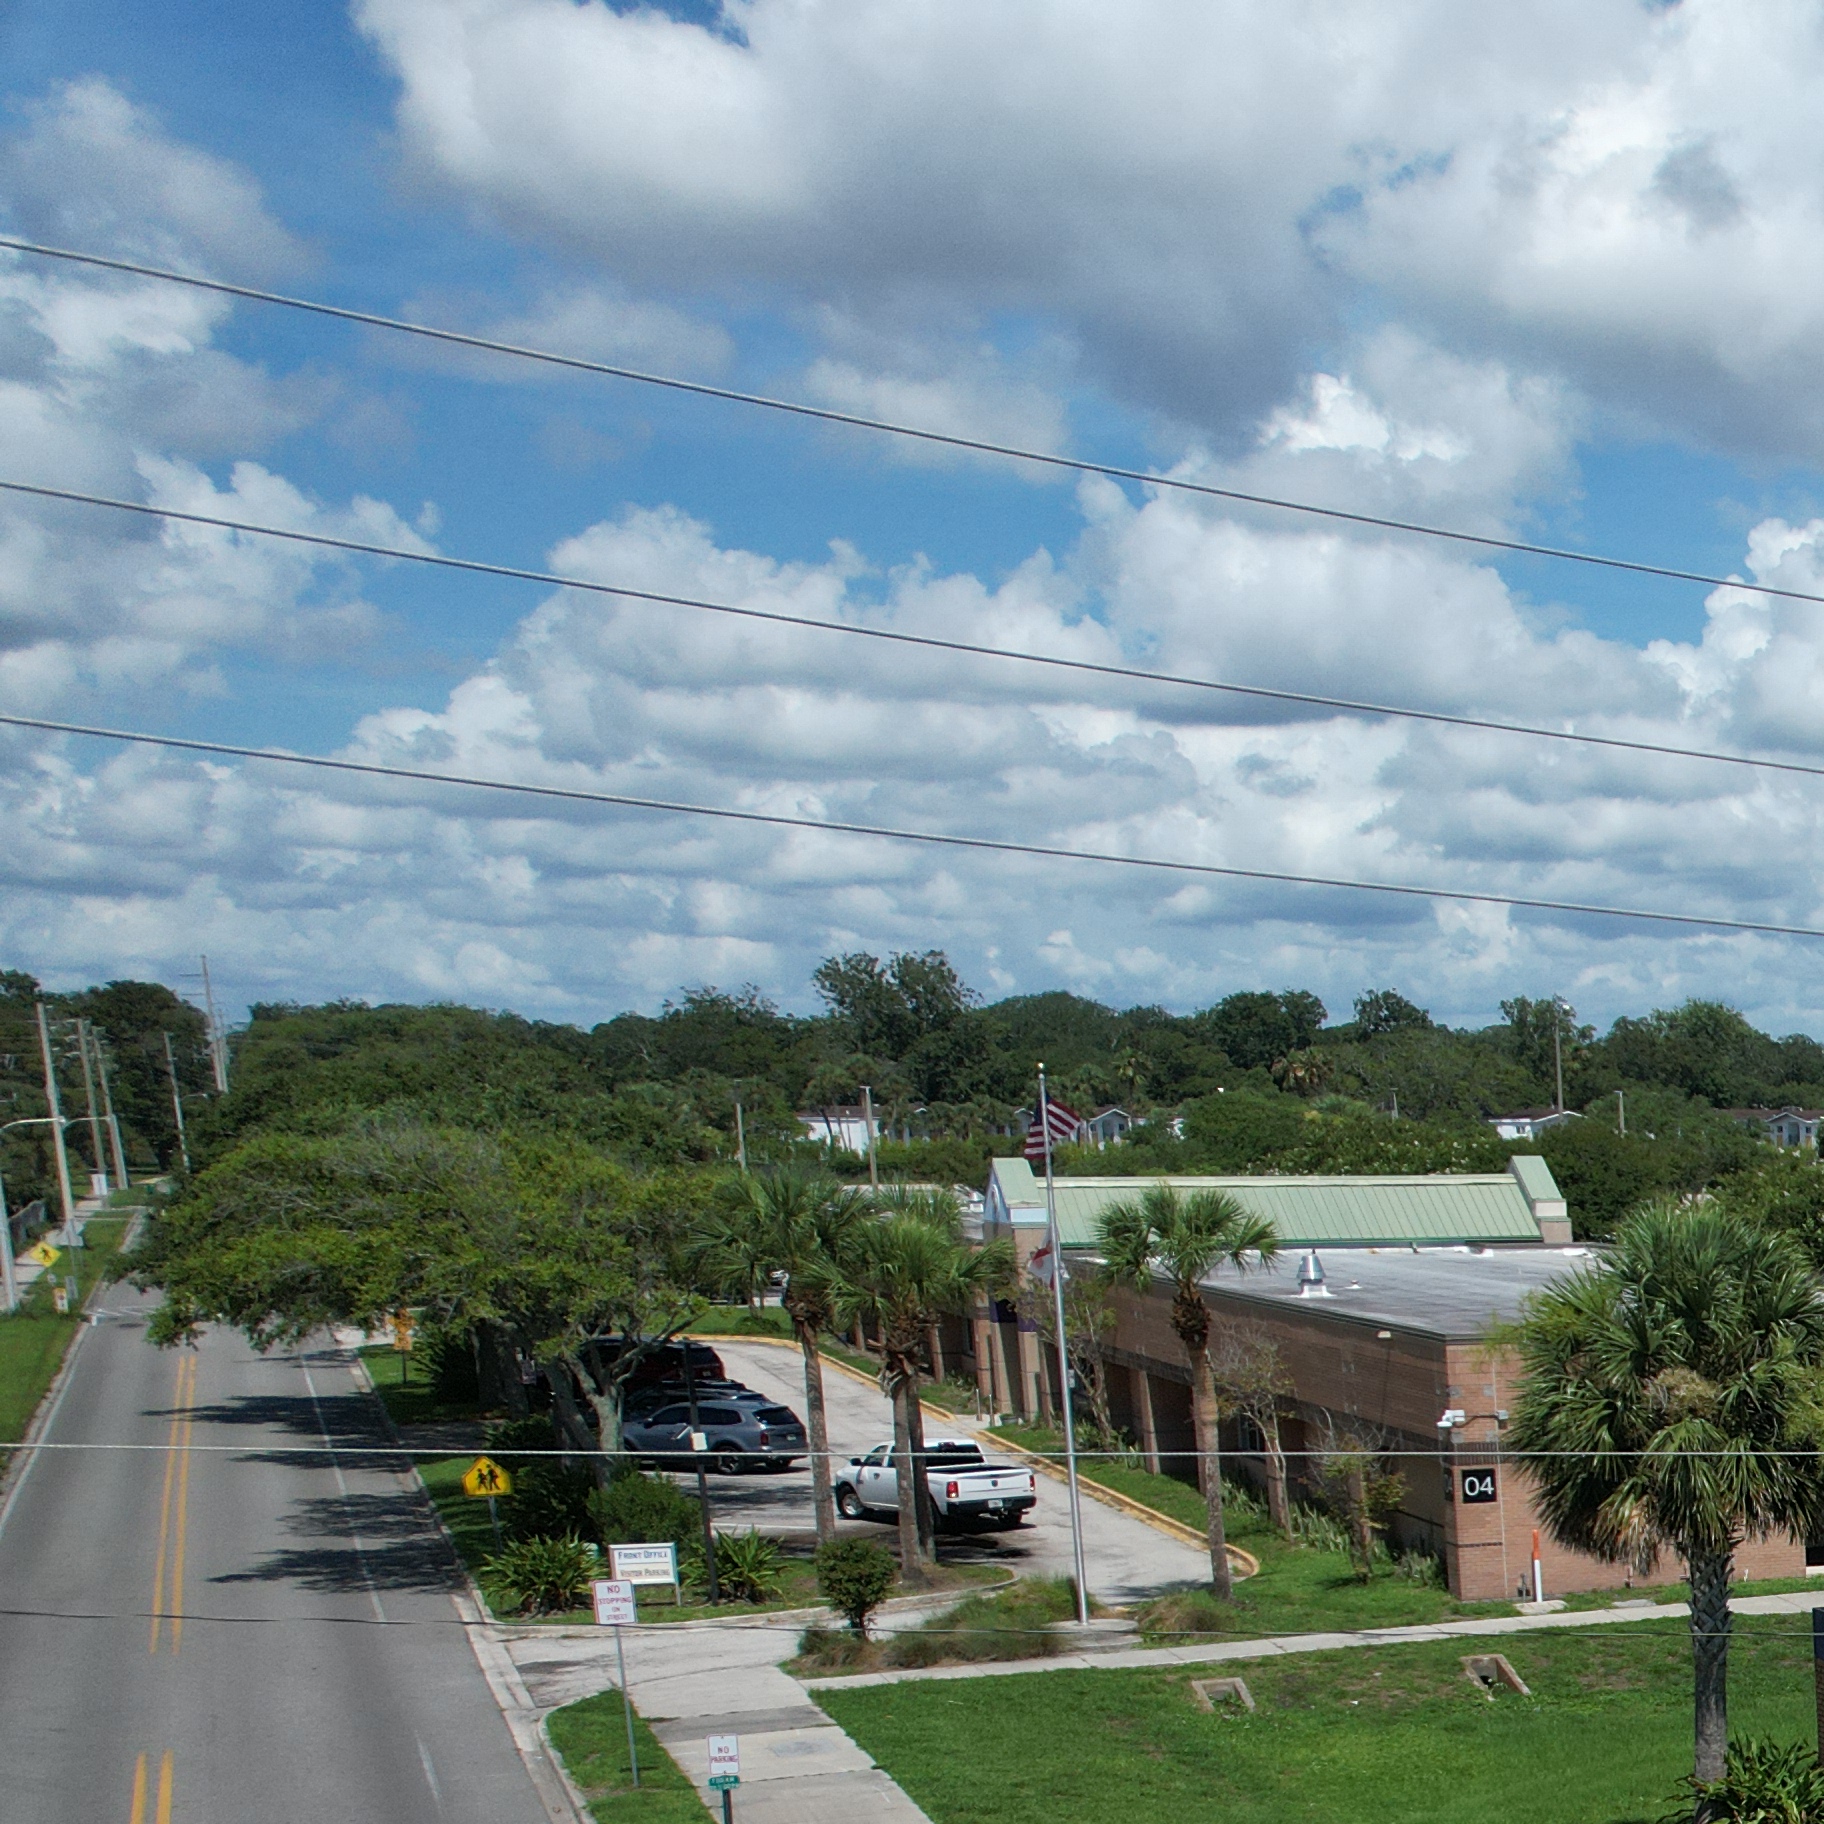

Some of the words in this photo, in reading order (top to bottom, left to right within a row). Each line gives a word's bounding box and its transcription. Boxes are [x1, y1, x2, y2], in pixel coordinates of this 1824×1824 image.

[1464, 1476, 1495, 1496] 04
[607, 1585, 620, 1594] NO
[717, 1746, 730, 1754] NO
